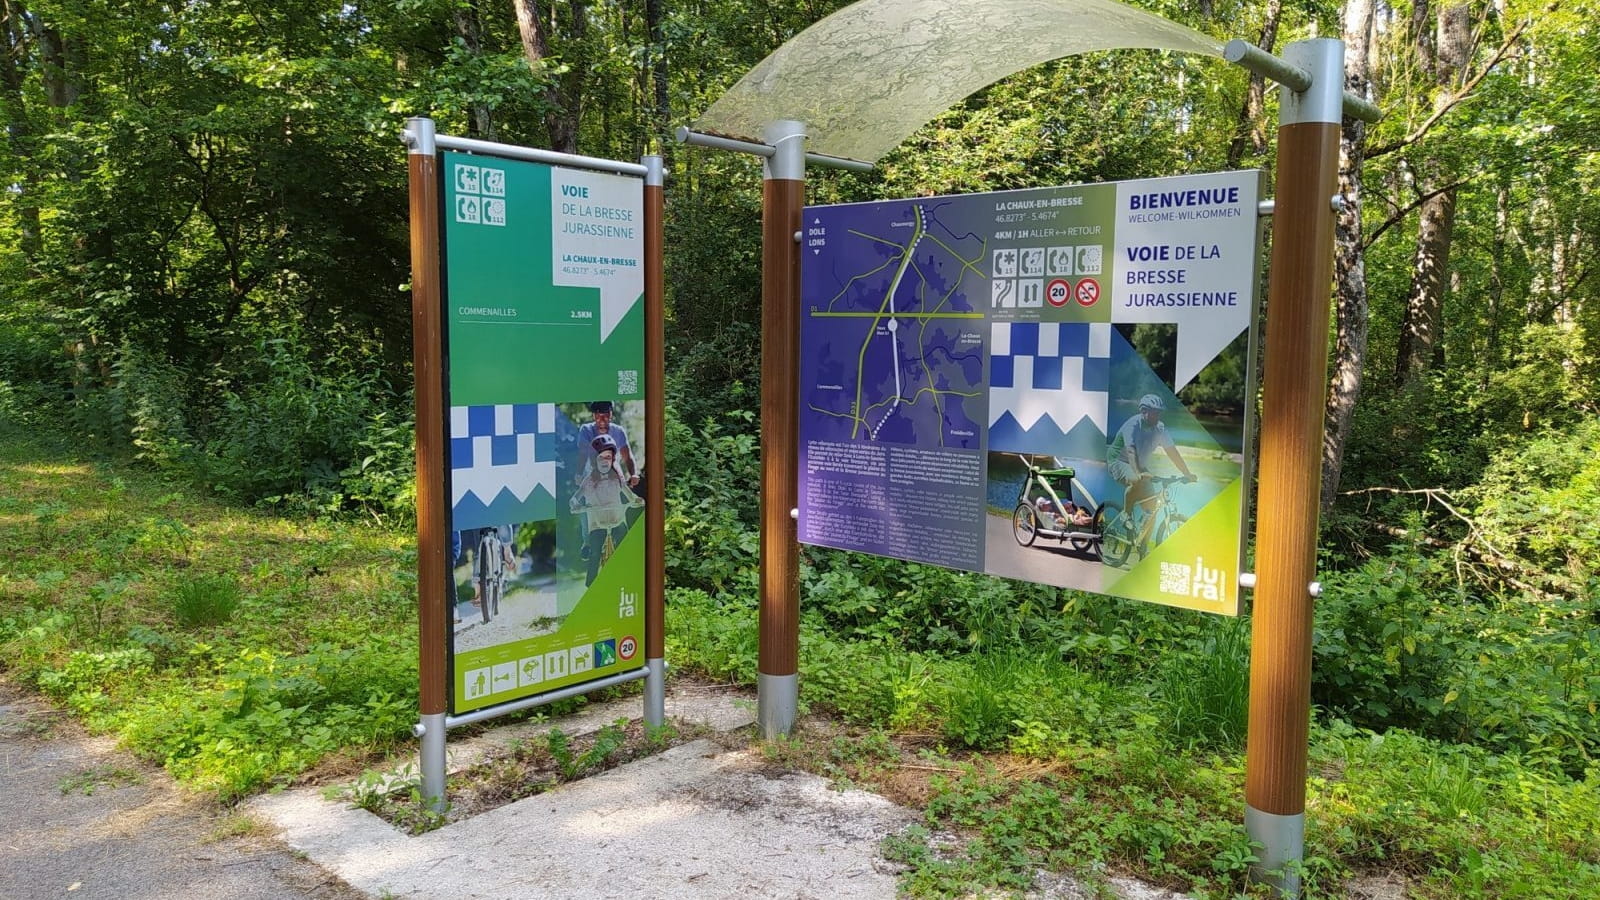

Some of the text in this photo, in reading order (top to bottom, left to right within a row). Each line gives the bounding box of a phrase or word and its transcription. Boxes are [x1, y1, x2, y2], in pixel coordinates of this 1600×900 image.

[561, 184, 589, 198] VOIE
[995, 197, 1083, 211] LA CHAUX-EN-BRESSE
[1130, 187, 1239, 210] BIENVENUE
[562, 203, 633, 222] DE LA BRESSE
[1128, 208, 1241, 223] WELCOME-WILKOMMEN
[562, 221, 634, 239] JURASSIENNE
[808, 228, 826, 236] DOLE
[994, 231, 1012, 240] 4KM
[1018, 229, 1029, 239] 1H
[1030, 228, 1055, 238] ALLER
[1067, 225, 1101, 236] RETOUR
[808, 238, 826, 247] LONS
[1127, 245, 1221, 262] VOIE DE LA
[572, 255, 637, 267] CHAUX-EN-BRESSE
[1126, 270, 1186, 285] BRESSE
[1052, 288, 1065, 297] 20
[1126, 292, 1237, 308] JURASSIENNE
[459, 306, 517, 317] COMMENAILLES
[622, 643, 633, 653] 20
